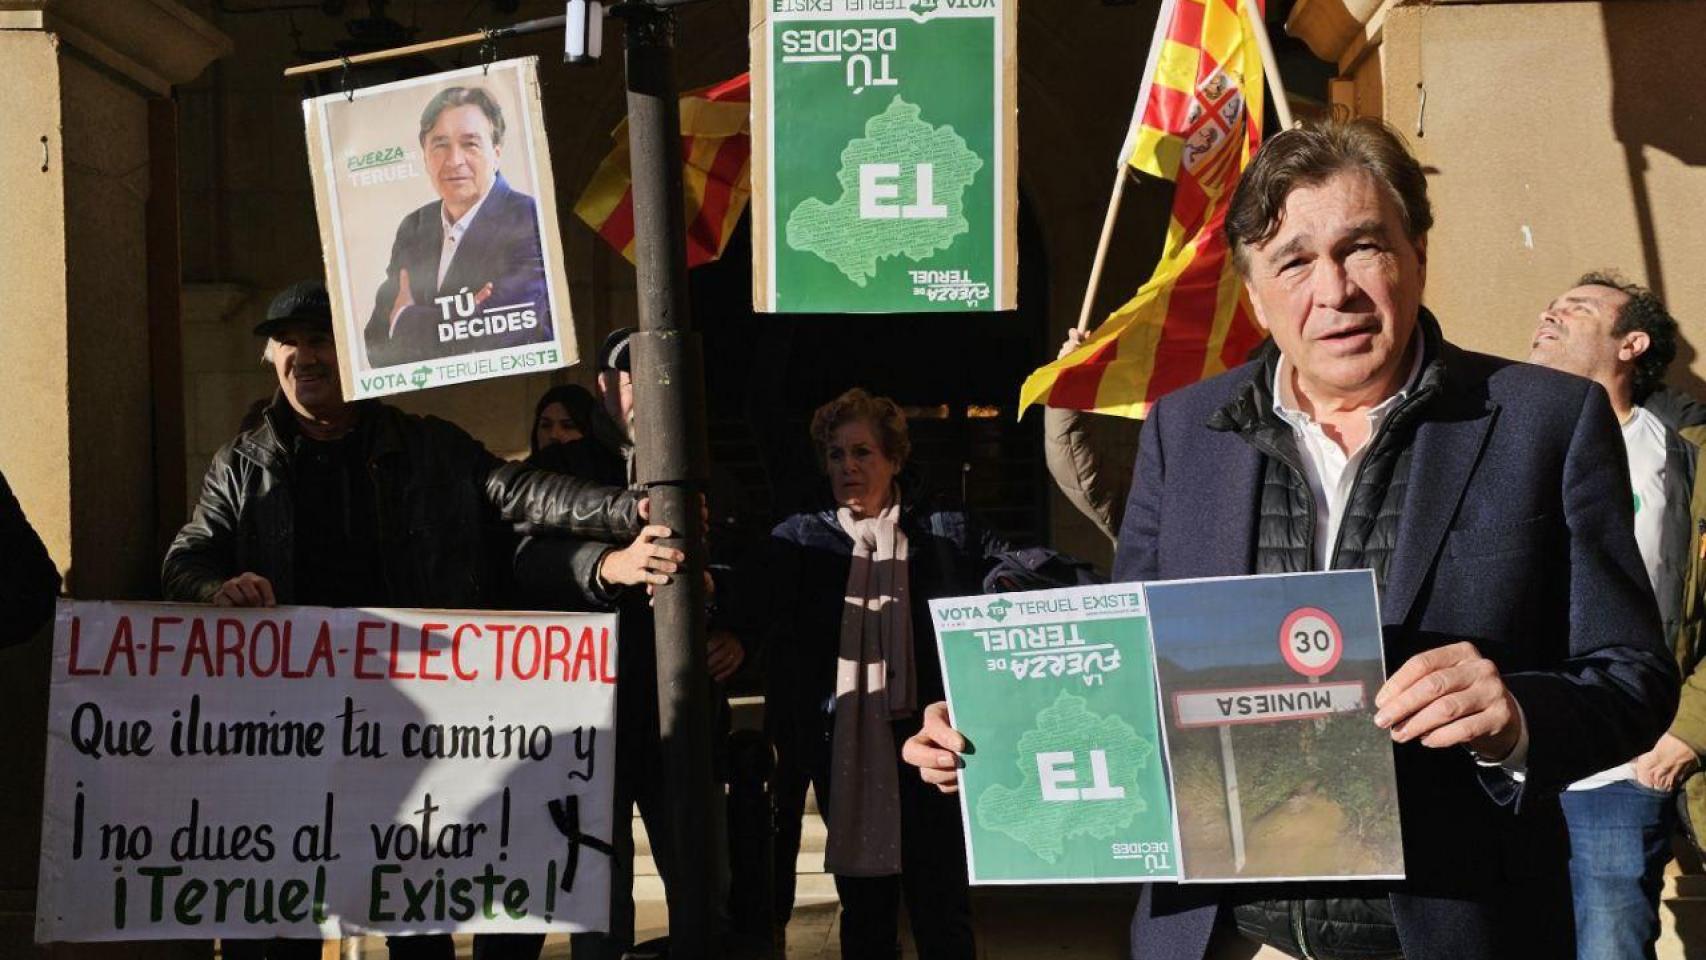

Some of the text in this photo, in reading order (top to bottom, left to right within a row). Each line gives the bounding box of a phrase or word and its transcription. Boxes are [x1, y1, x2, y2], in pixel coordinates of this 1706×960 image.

[782, 28, 897, 53] DECIDES
[847, 54, 898, 94] TÚ
[347, 146, 404, 169] FUERZA
[348, 162, 420, 187] TERUEL
[908, 270, 972, 284] TERUEL
[434, 286, 475, 320] TÚ
[926, 286, 990, 301] FUERZA
[966, 300, 978, 308] LA
[438, 310, 537, 342] DECIDES
[360, 373, 408, 392] VOTA
[436, 359, 498, 381] TERUEL
[938, 606, 983, 621] VOTA
[1015, 598, 1078, 615] TERUEL
[974, 623, 1085, 651] TERUEL
[1294, 630, 1330, 653] 30
[986, 648, 1121, 680] FUERZA DE
[1083, 673, 1102, 686] LA
[1217, 690, 1331, 716] MUNIESA
[71, 694, 597, 781] Que ilumine tu camino y
[171, 798, 276, 862] dues
[292, 792, 340, 862] al
[1111, 842, 1169, 853] DECIDES
[1145, 854, 1170, 873] TÚ
